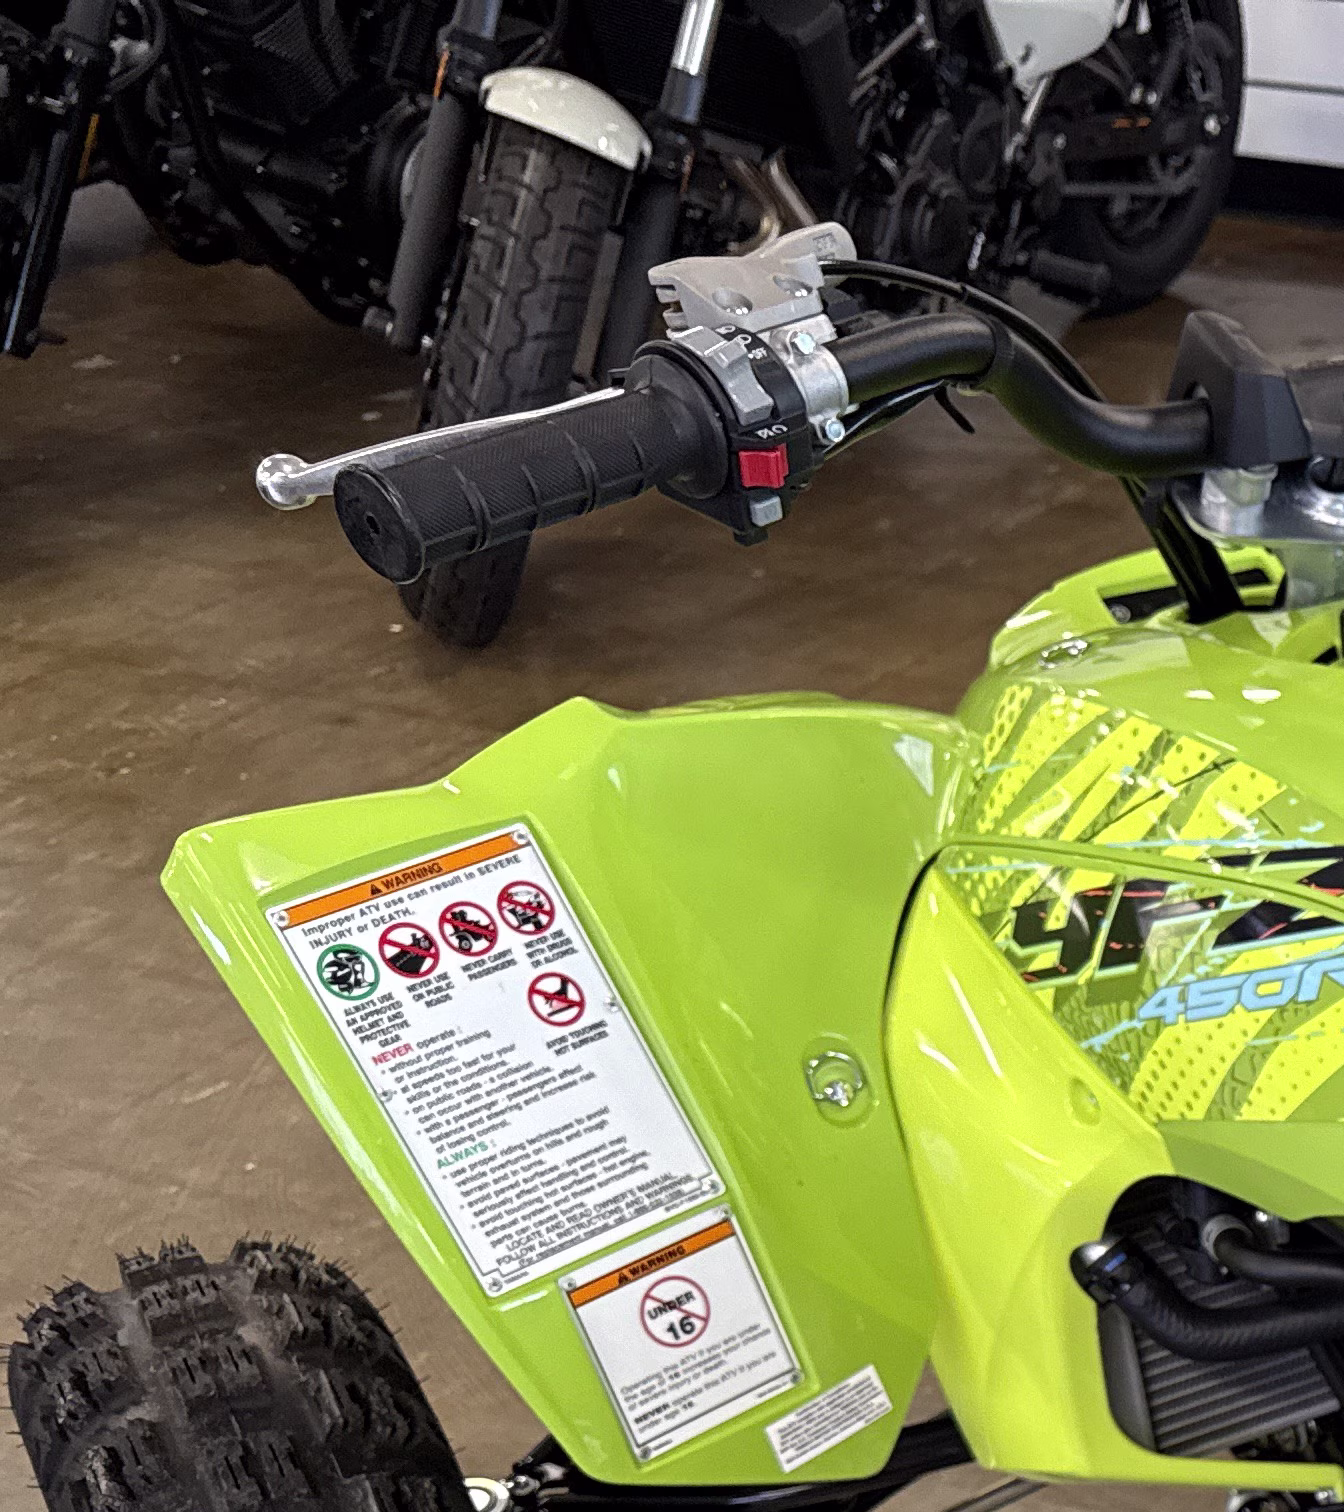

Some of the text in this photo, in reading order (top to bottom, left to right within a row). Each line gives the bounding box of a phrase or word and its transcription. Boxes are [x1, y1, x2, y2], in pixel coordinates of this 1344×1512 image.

[380, 860, 444, 891] WARNING
[300, 853, 522, 937] Improper ATV use can result in SEVERE
[308, 906, 416, 950] INJURY or DEATH.
[371, 1029, 457, 1067] NEVER operate
[436, 1140, 489, 1170] ALWAYS
[628, 1245, 686, 1277] WARNING
[647, 1290, 696, 1320] UNDER
[666, 1315, 696, 1342] 16
